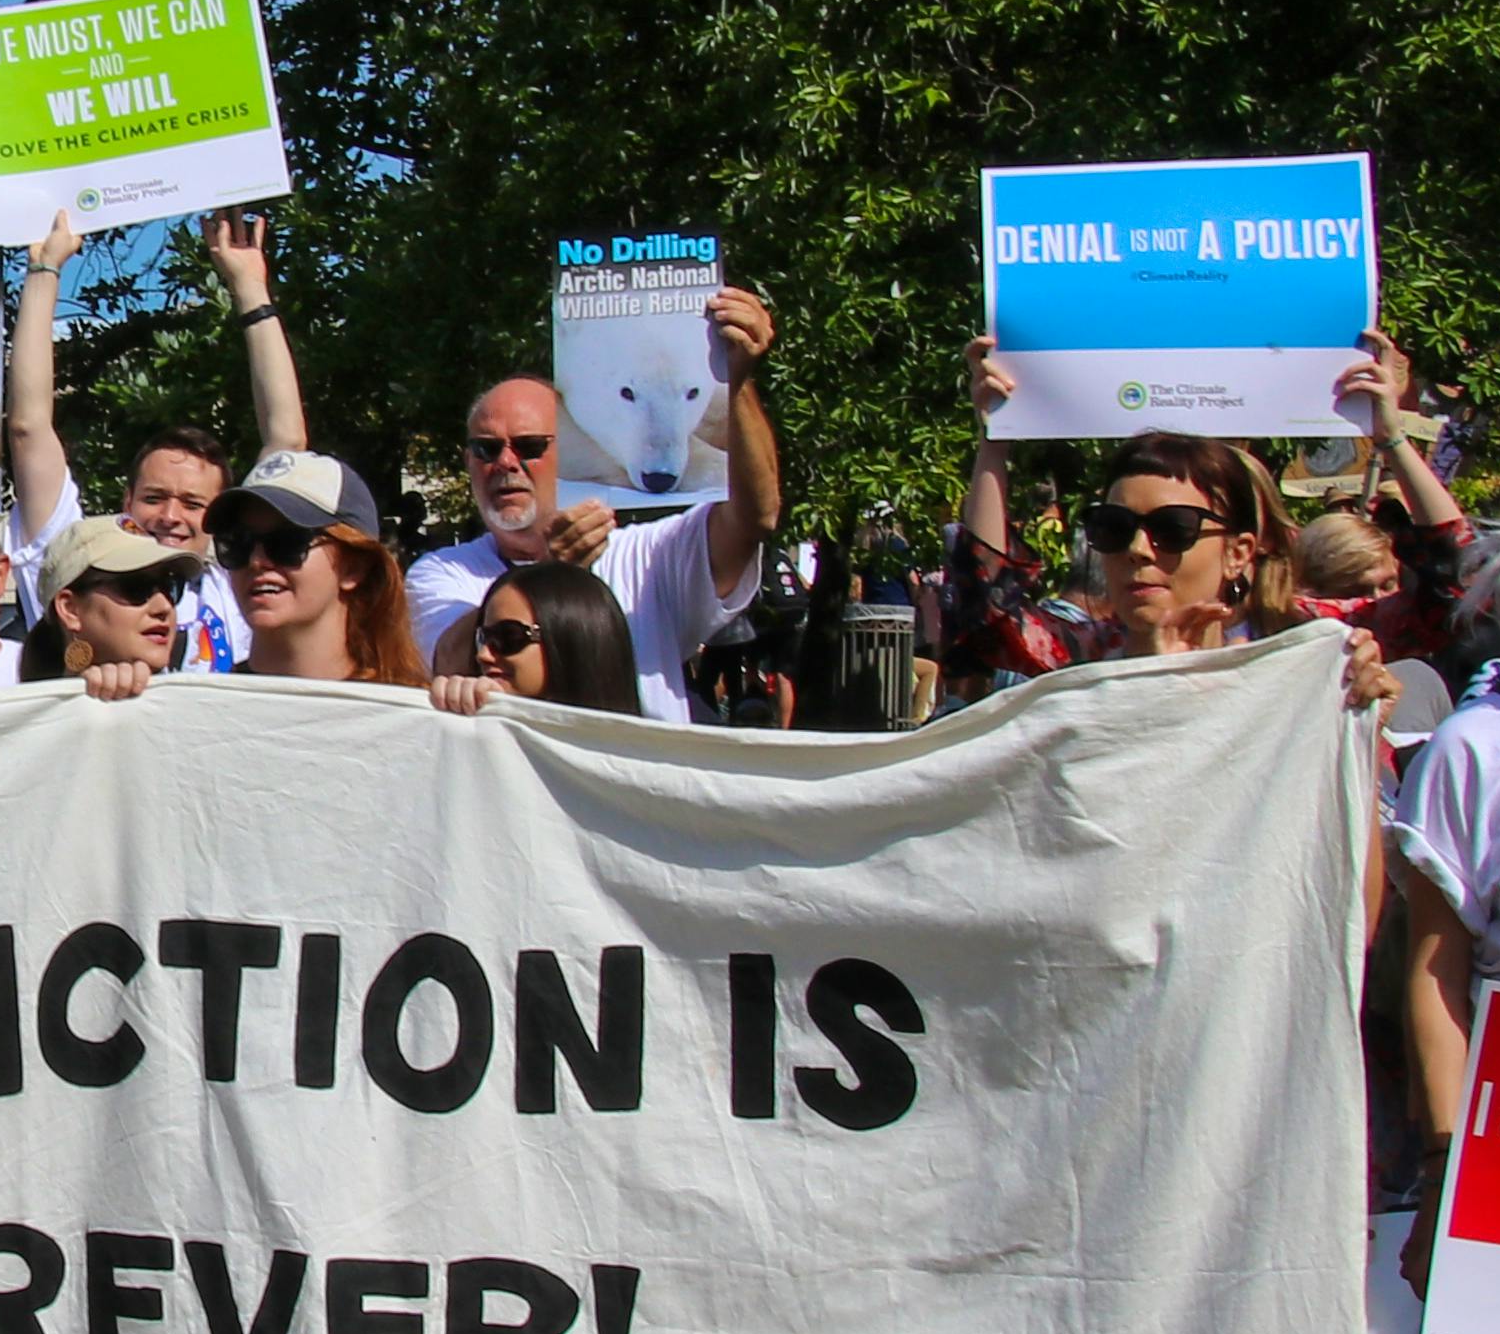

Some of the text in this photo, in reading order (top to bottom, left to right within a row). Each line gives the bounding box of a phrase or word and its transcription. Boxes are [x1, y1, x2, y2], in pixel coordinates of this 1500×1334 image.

[24, 14, 113, 60] MUST,
[117, 4, 162, 44] WE
[89, 52, 125, 80] AND
[46, 73, 178, 127] WE WILL
[55, 134, 91, 151] THE
[97, 118, 180, 144] CLIMATE
[186, 103, 250, 126] CRISIS
[558, 233, 716, 266] No Drilling
[996, 218, 1361, 264] DENIAL IS NOT A POLICY
[558, 262, 718, 294] Arctic National
[558, 293, 642, 320] Wildlife
[1149, 383, 1227, 395] The Climate
[1150, 395, 1245, 409] Reality Project
[727, 951, 928, 1133] IS
[1473, 1080, 1493, 1137] I
